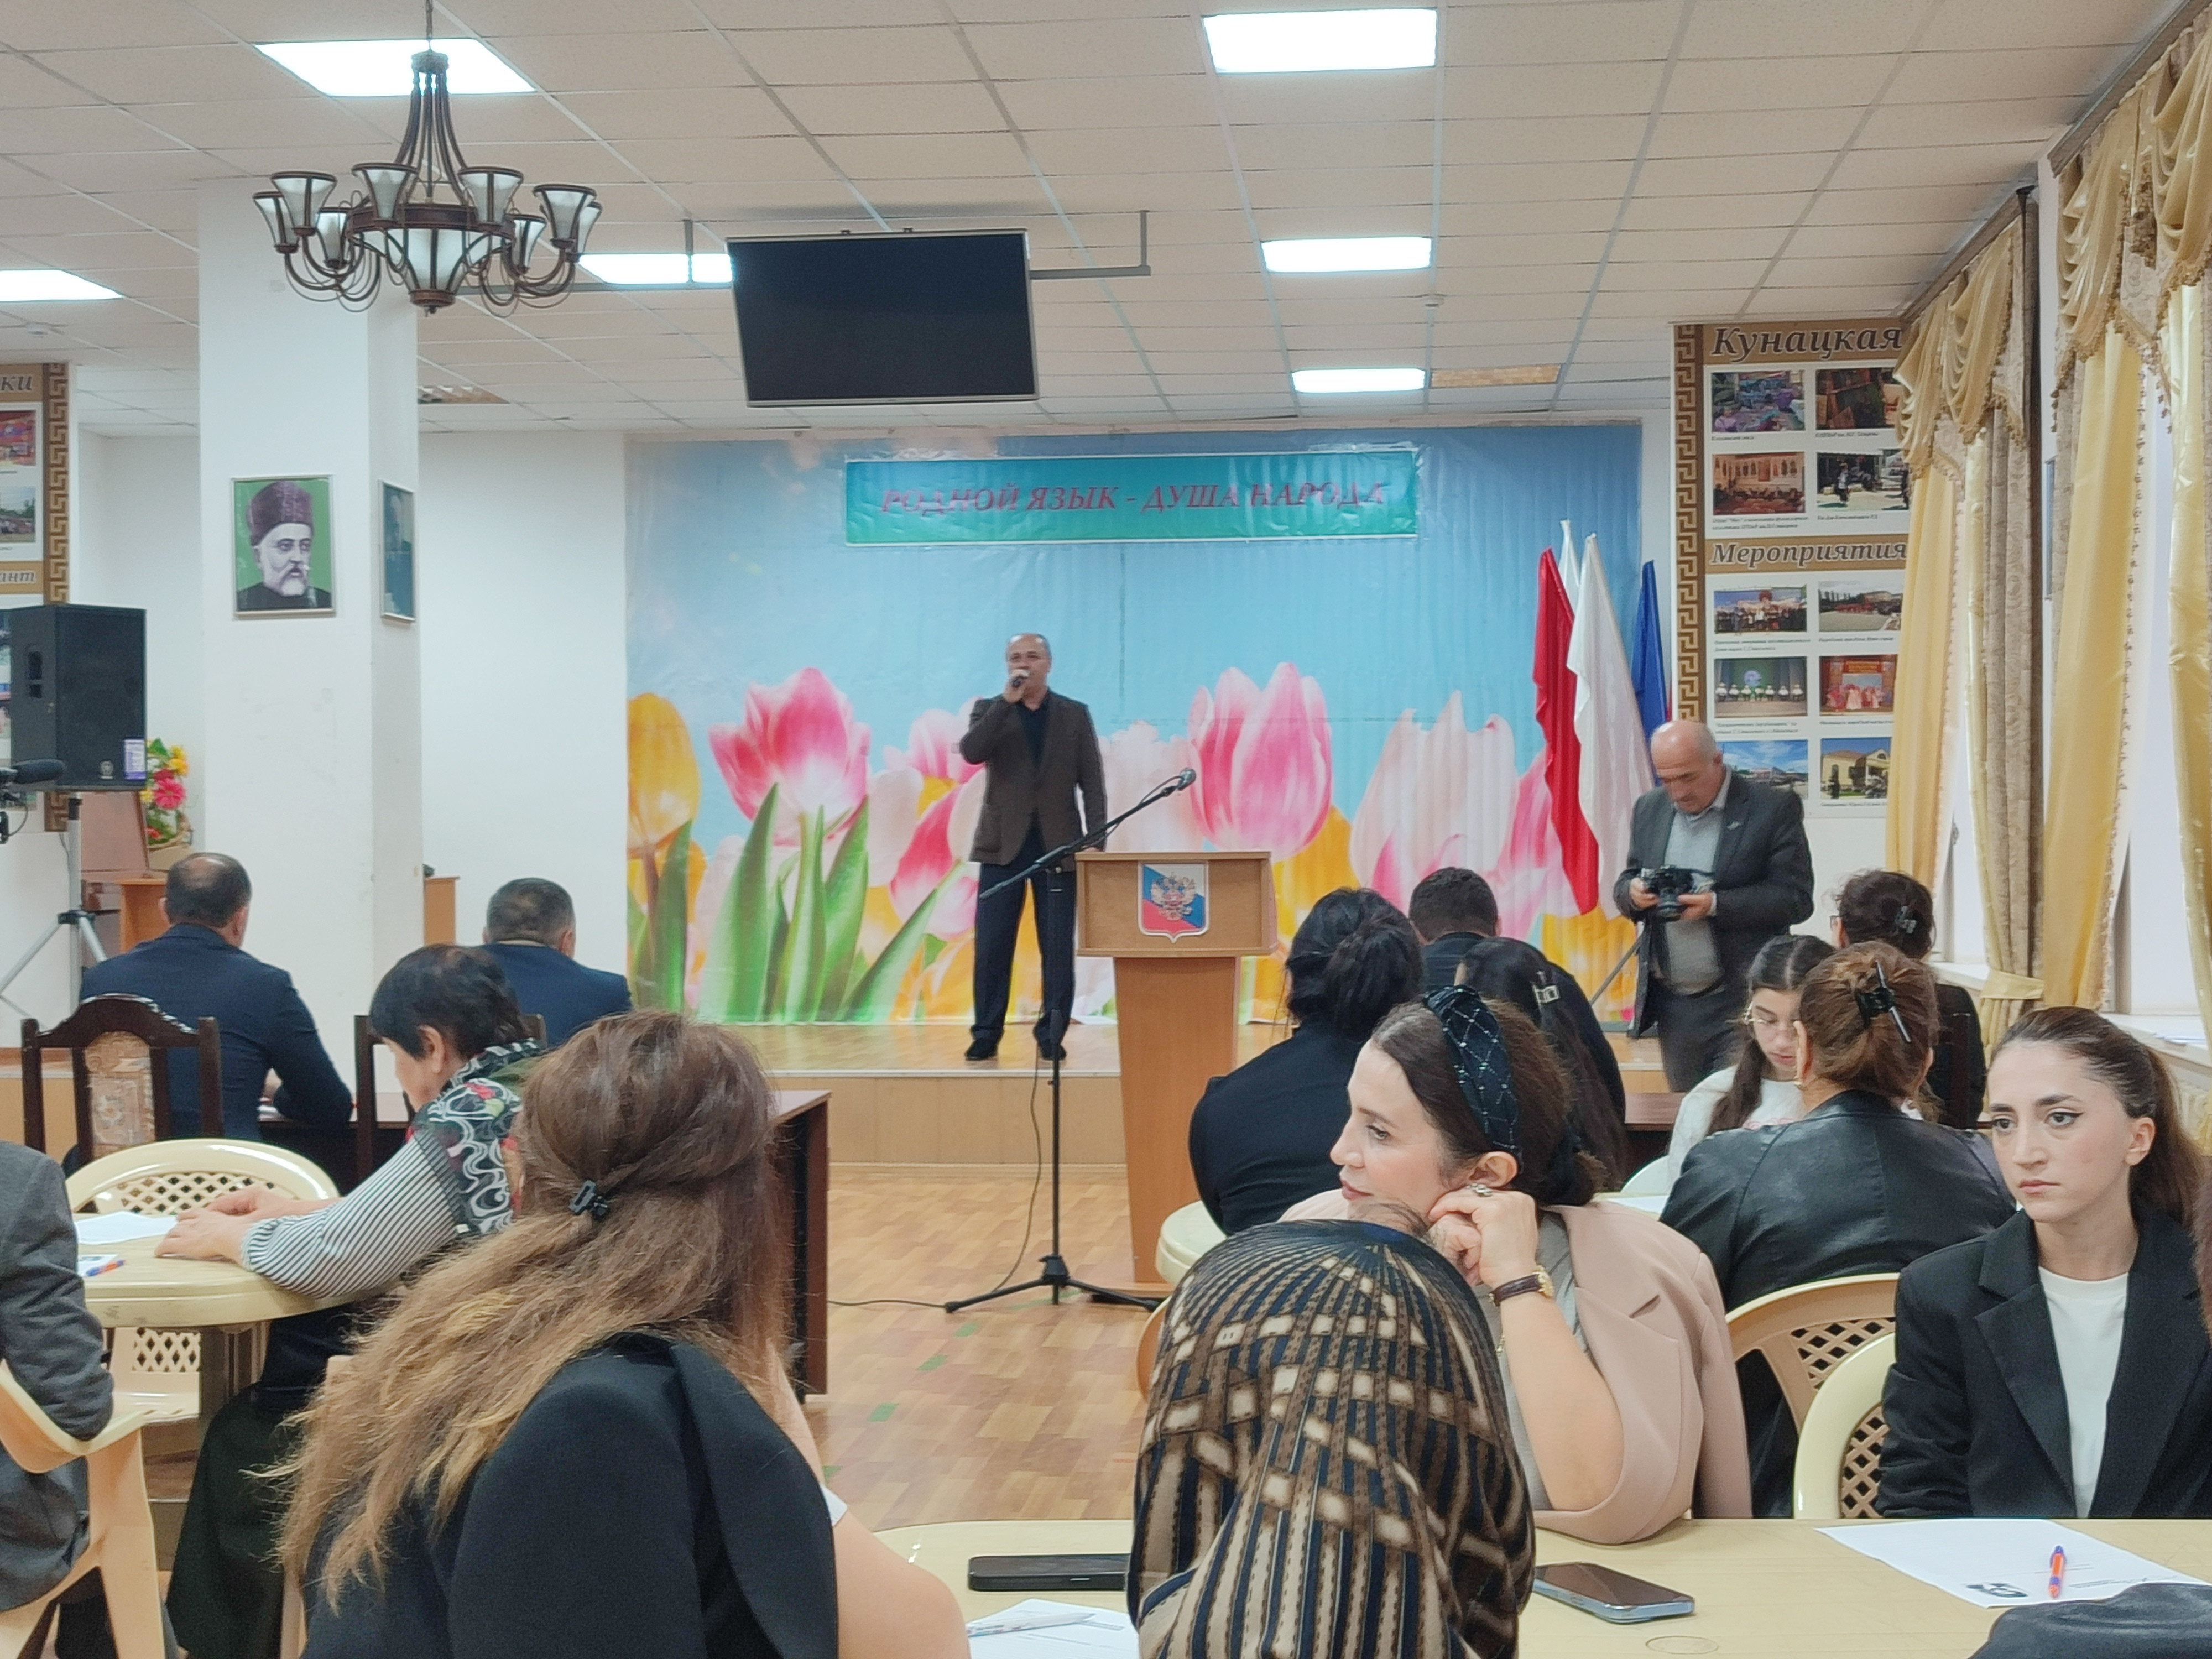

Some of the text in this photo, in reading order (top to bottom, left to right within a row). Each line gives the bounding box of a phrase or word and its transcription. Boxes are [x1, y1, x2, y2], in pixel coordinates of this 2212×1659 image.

[1710, 327, 1902, 363] Кунацкая
[881, 482, 1019, 516] РОДНОЙ
[1026, 486, 1119, 510] ЯЗЫК
[1140, 483, 1240, 514] ДУША
[1248, 481, 1392, 510] НАРОДА
[1712, 542, 1906, 567] Мероприятия
